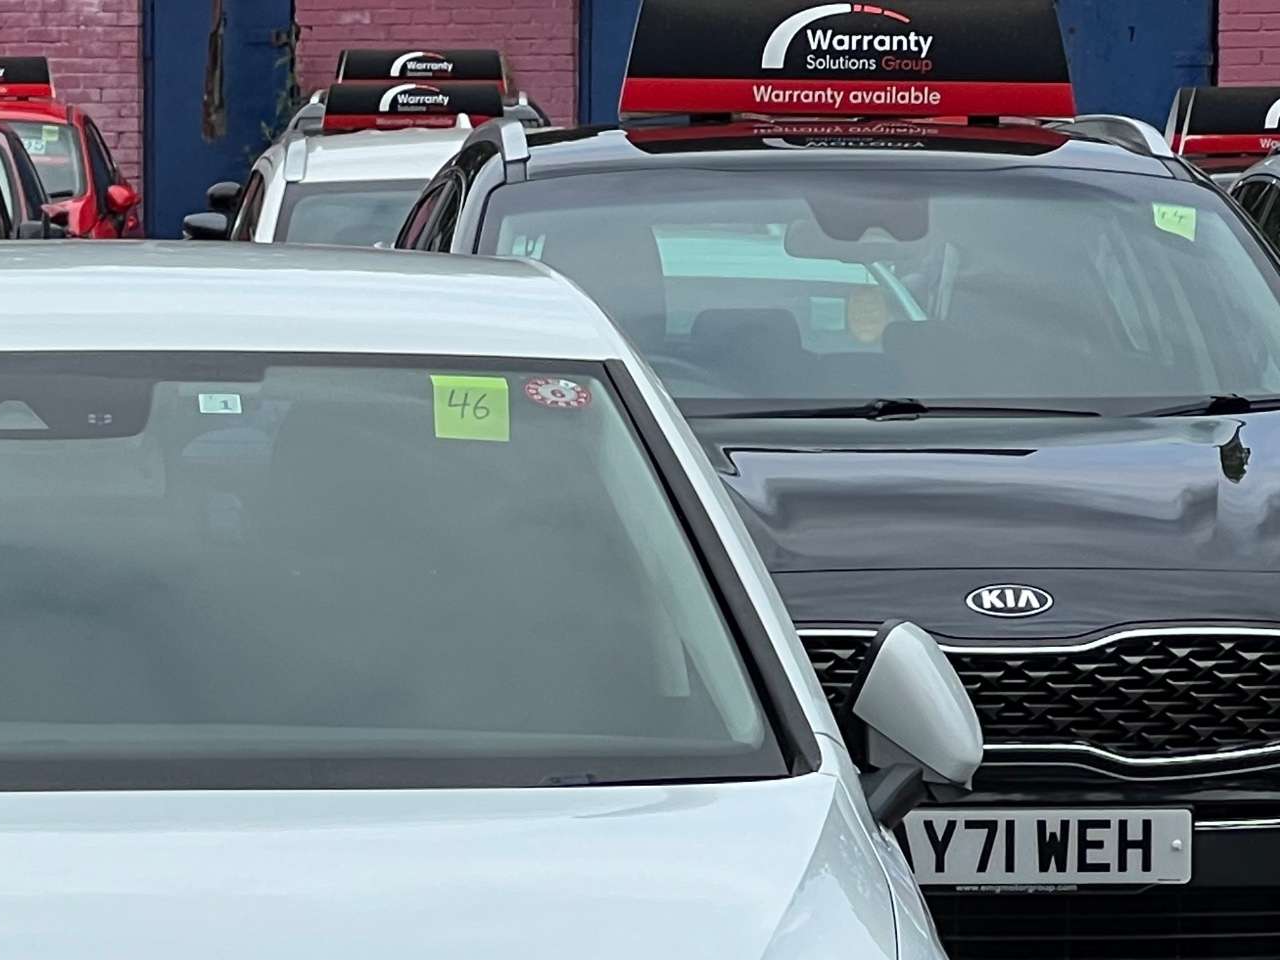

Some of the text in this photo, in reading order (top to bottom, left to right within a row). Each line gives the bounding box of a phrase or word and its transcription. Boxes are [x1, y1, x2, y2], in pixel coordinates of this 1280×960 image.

[806, 29, 934, 58] Warranty
[806, 54, 933, 73] Solutions Group
[397, 94, 449, 106] Warranty
[752, 84, 941, 108] Warranty available
[447, 388, 491, 420] 46
[981, 588, 1041, 609] KIA
[897, 819, 1153, 875] Y71 WEH
